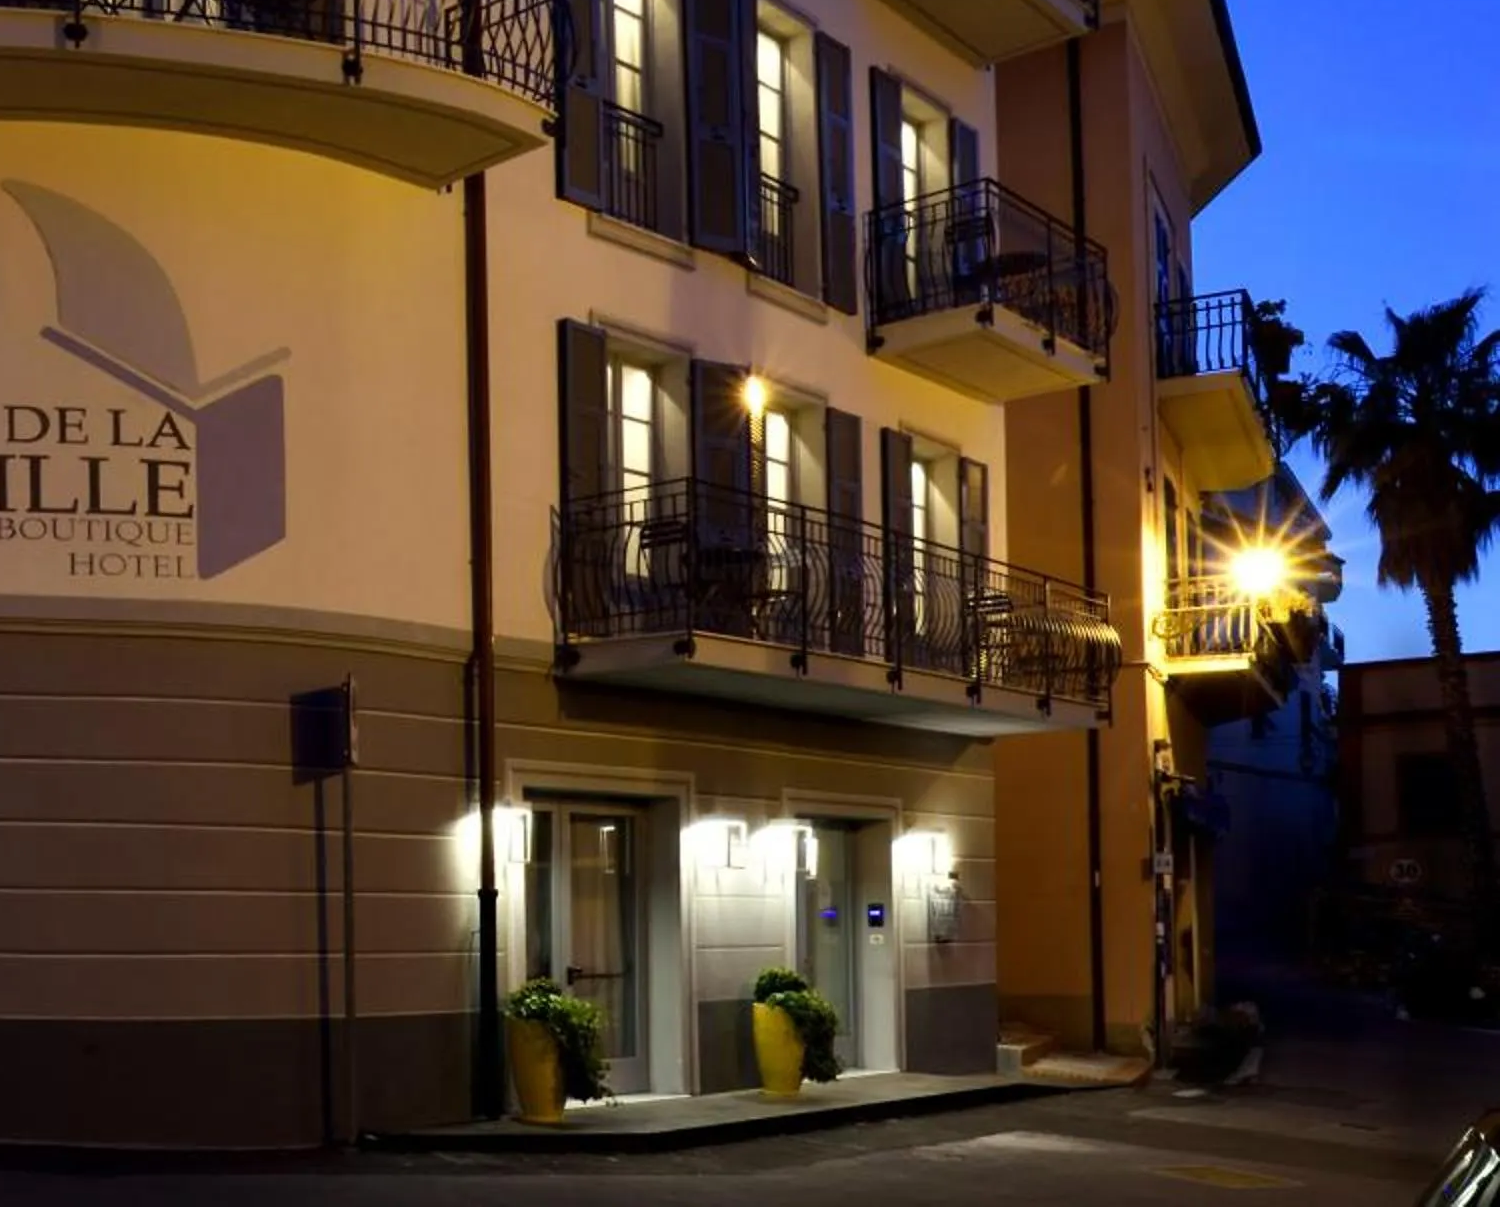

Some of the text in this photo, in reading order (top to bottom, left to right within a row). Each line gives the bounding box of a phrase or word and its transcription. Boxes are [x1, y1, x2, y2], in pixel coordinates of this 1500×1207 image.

[3, 405, 192, 451] DE LA
[68, 552, 195, 579] HOTEL
